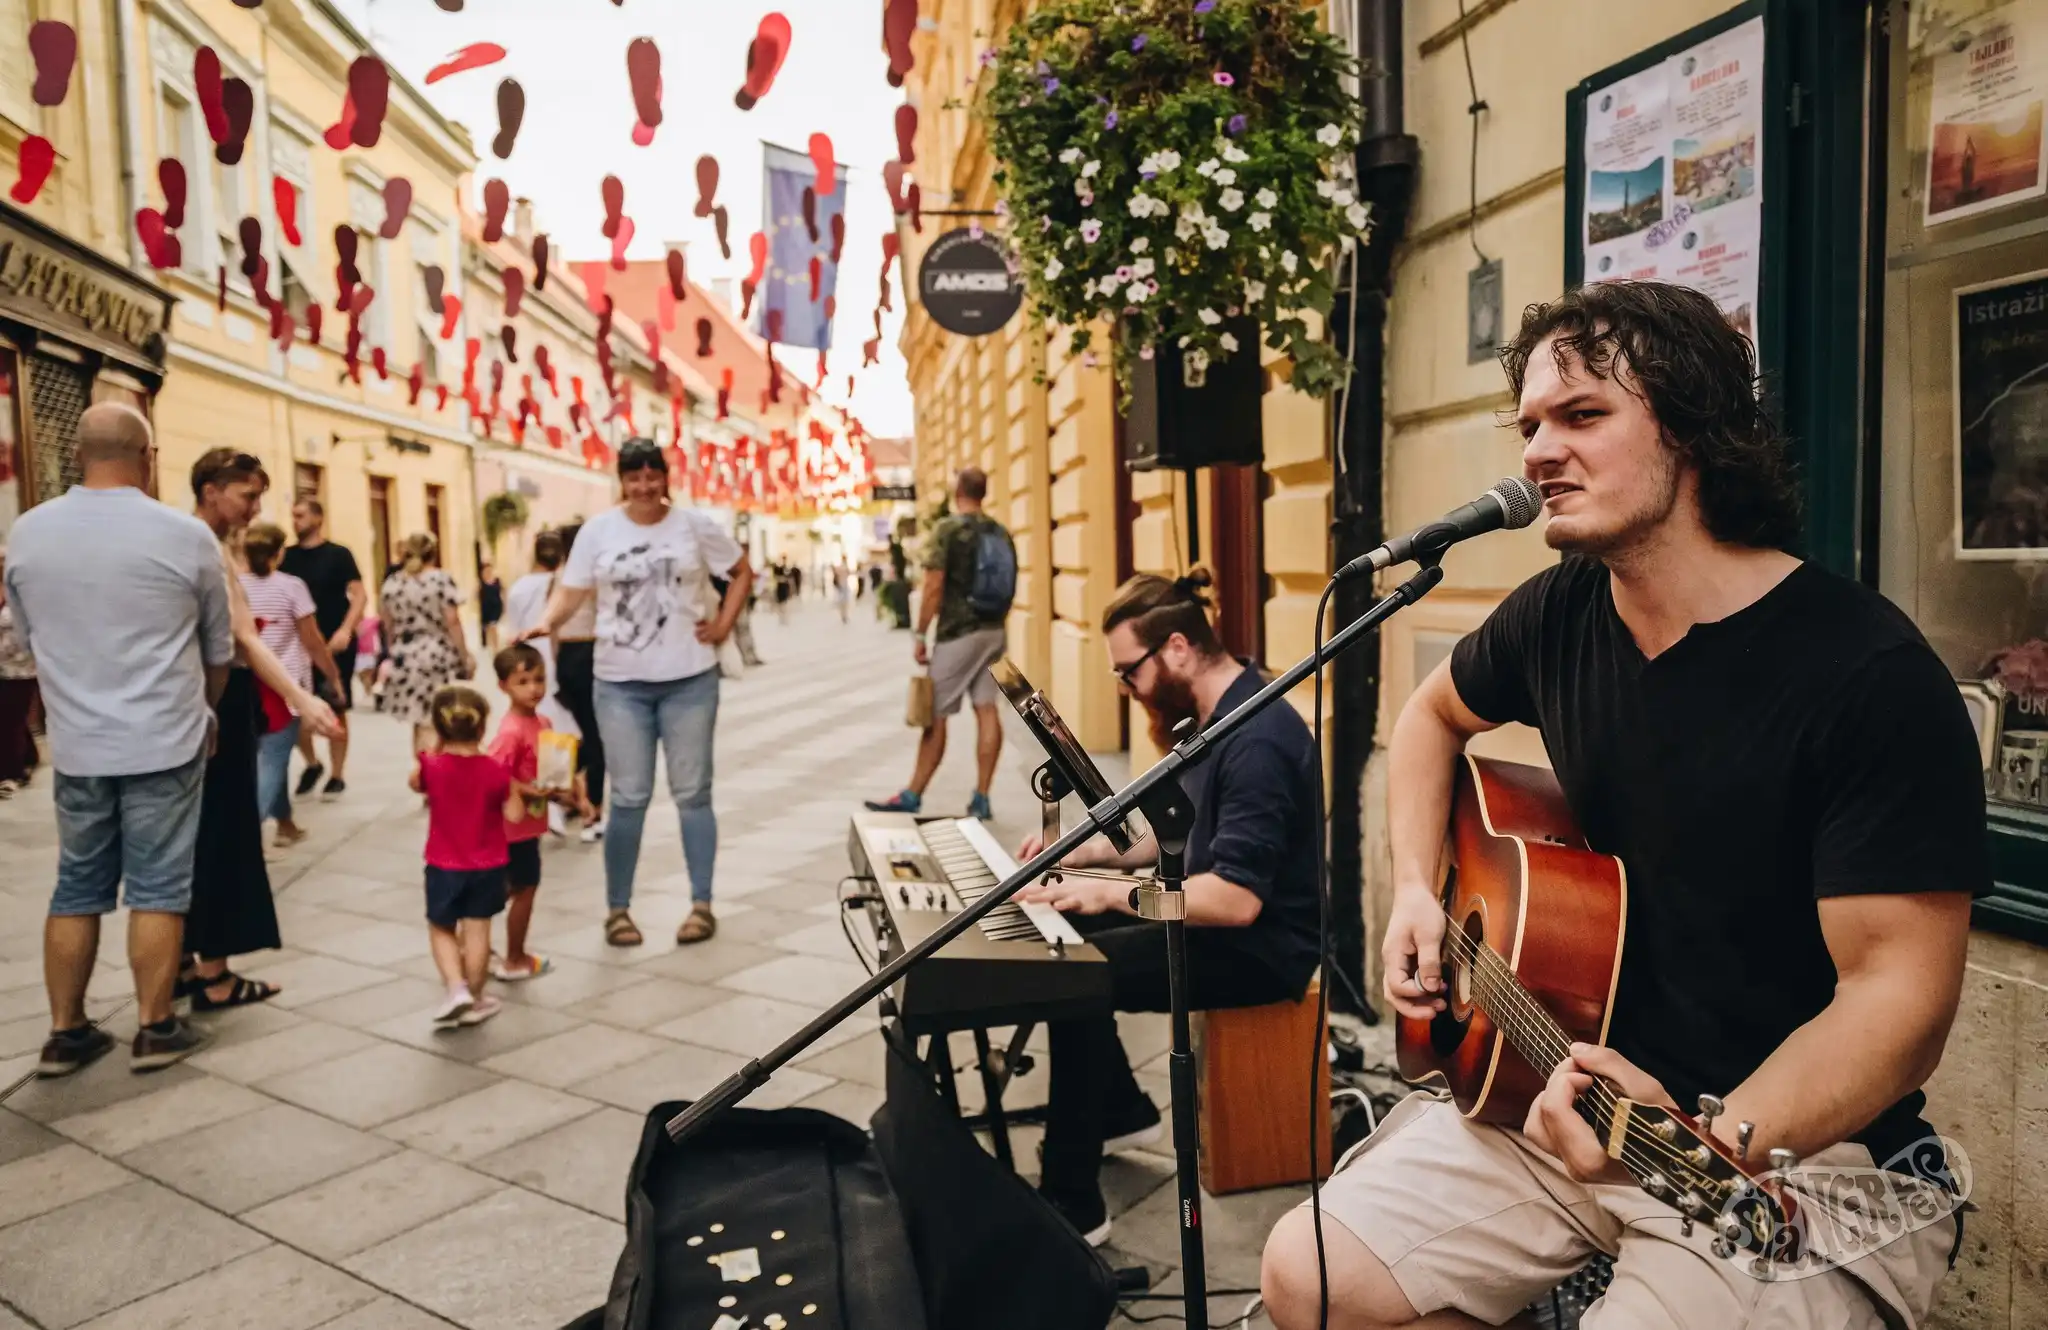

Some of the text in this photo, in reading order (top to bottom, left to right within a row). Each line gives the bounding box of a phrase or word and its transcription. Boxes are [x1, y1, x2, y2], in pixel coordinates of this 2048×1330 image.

[934, 272, 1009, 292] AMOS
[1966, 285, 2048, 325] Istraži
[1183, 1199, 1191, 1228] CAYMON
